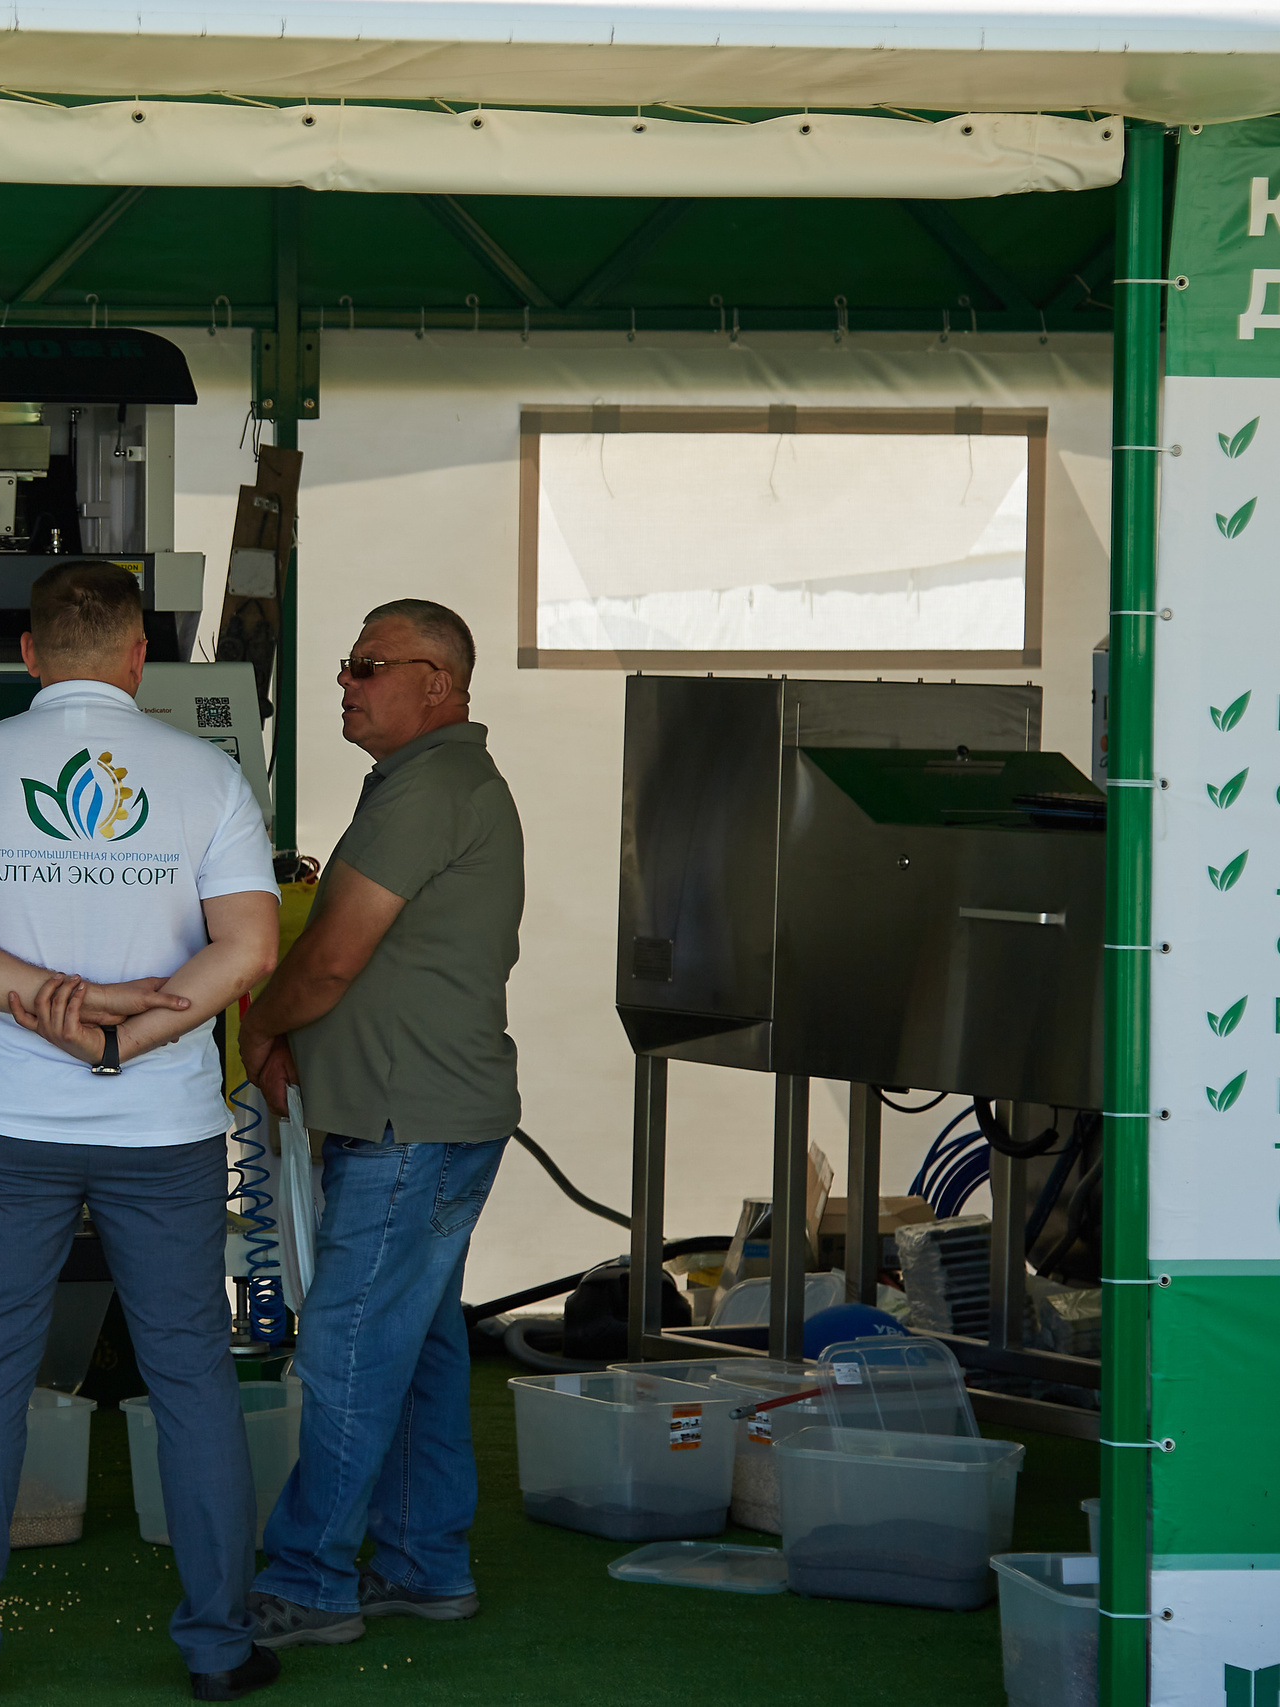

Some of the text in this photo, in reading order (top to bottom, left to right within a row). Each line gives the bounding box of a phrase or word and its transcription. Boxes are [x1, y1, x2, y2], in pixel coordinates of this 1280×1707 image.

[16, 849, 108, 861] ПРОМЫШЛЕННАЯ
[109, 851, 180, 863] КОРПОРАЦИЯ
[68, 865, 115, 885] ЭКО
[121, 866, 179, 886] СОРТ
